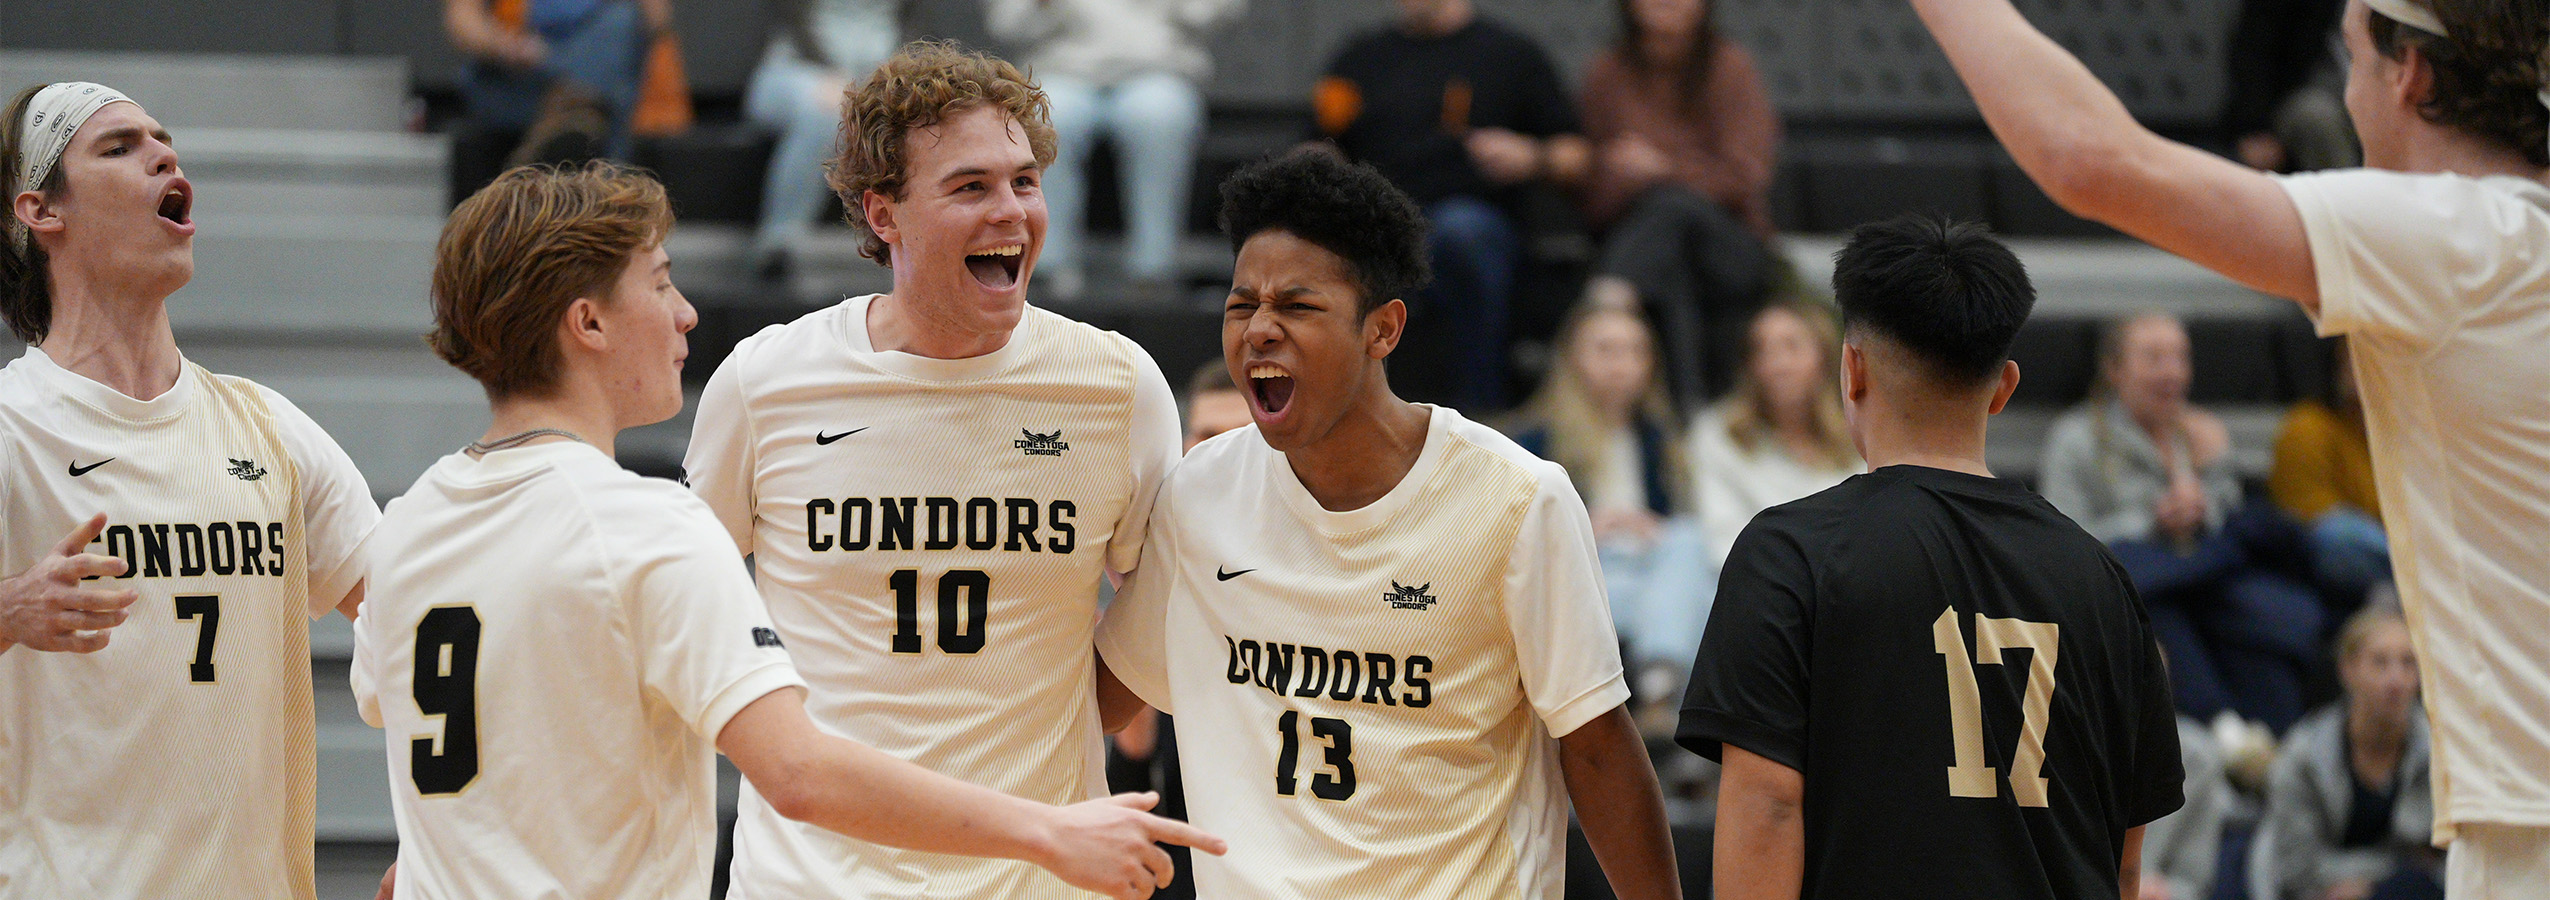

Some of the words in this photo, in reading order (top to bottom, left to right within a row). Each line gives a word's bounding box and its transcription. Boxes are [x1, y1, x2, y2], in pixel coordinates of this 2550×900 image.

[1014, 440, 1070, 451] CONESTOGA
[1024, 449, 1061, 457] CONDORS
[806, 496, 1077, 555] CONDORS
[889, 569, 991, 655] 10
[1383, 592, 1437, 605] CONESTOGA
[1392, 601, 1427, 611] CONDORS
[174, 595, 220, 683] 7
[411, 605, 482, 796] 9
[1933, 604, 2059, 808] 17
[1276, 709, 1357, 802] 13
